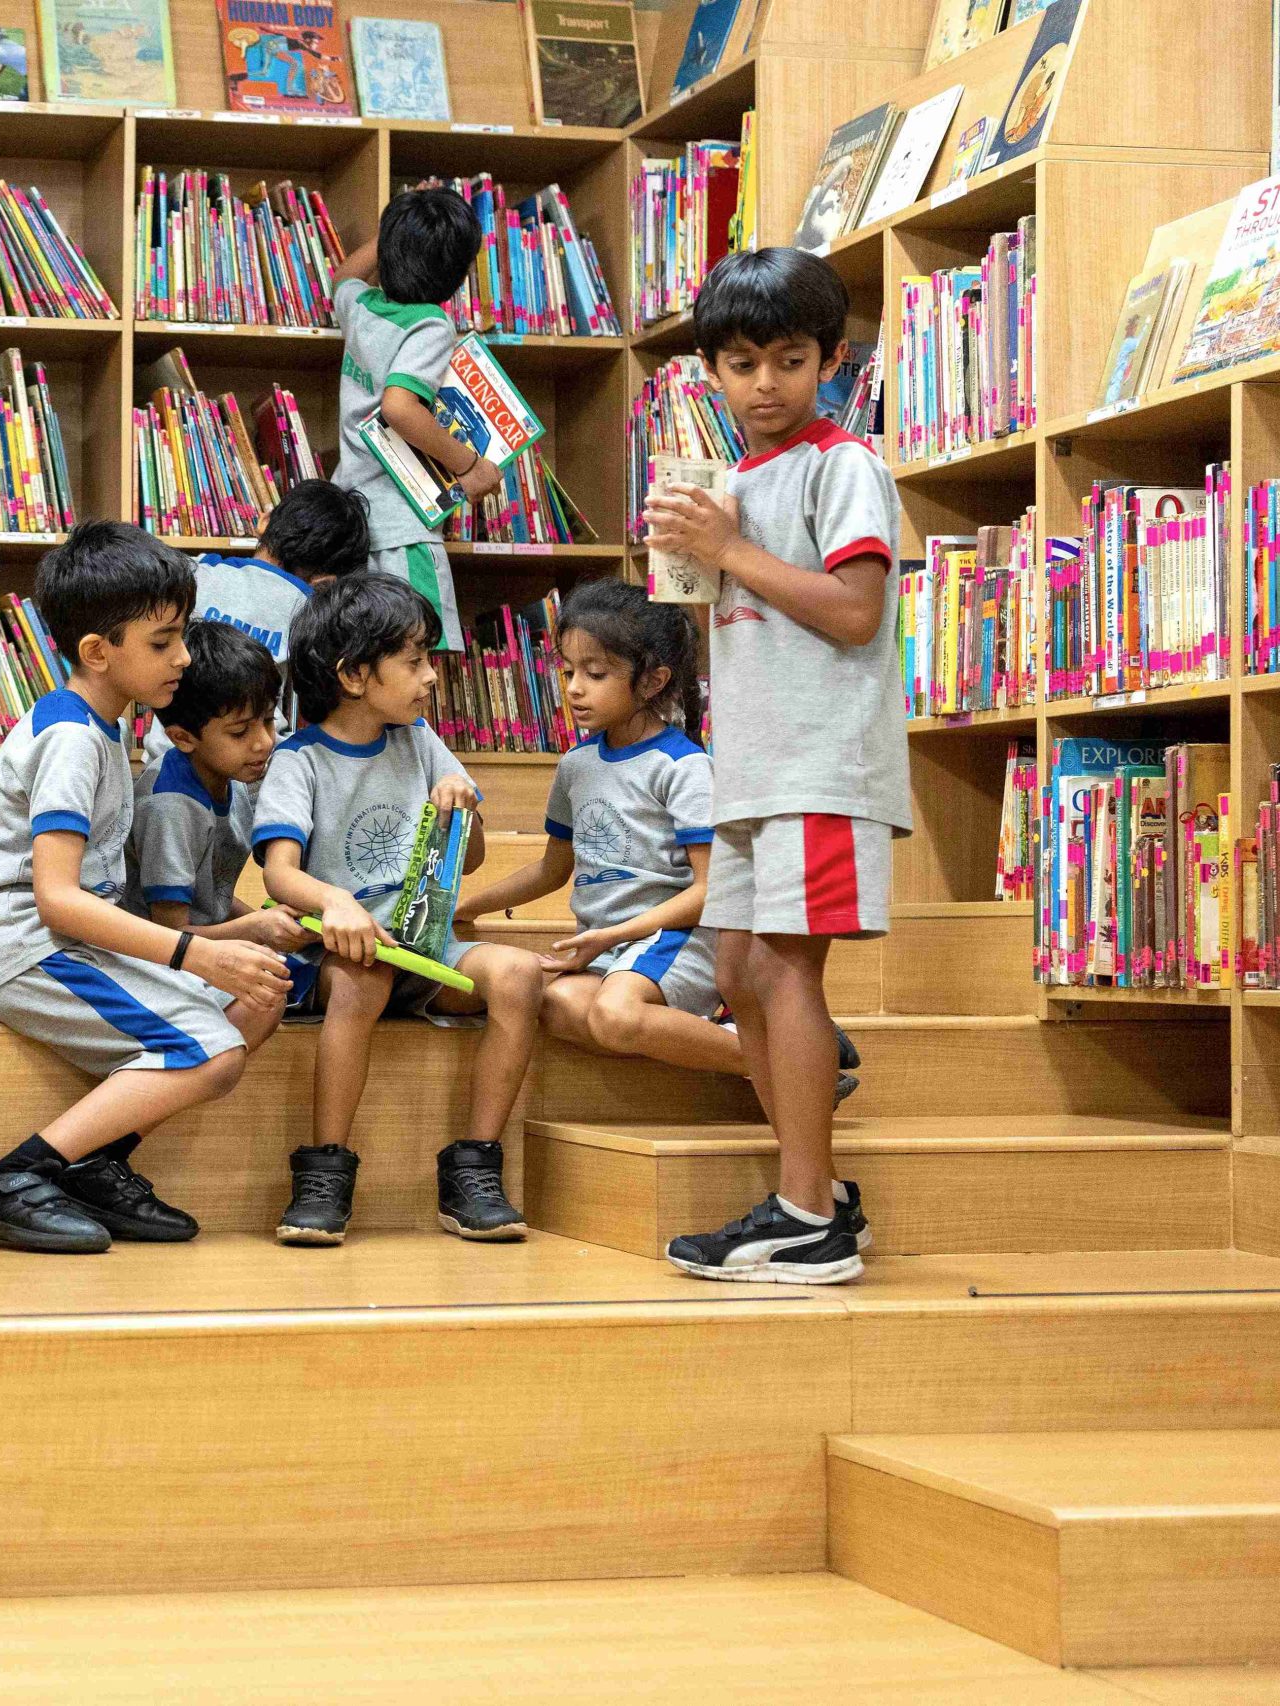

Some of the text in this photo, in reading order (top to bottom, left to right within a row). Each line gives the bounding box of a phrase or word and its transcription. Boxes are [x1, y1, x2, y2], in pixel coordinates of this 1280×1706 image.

[228, 0, 333, 28] HUMAN BODY
[556, 14, 610, 31] Transport
[450, 349, 524, 448] RACING CAR
[1106, 558, 1113, 570] of
[1106, 600, 1116, 640] World
[344, 803, 415, 885] THE BOMBAY INTERNATIONAL SCHOOL
[1221, 852, 1229, 878] KIDS
